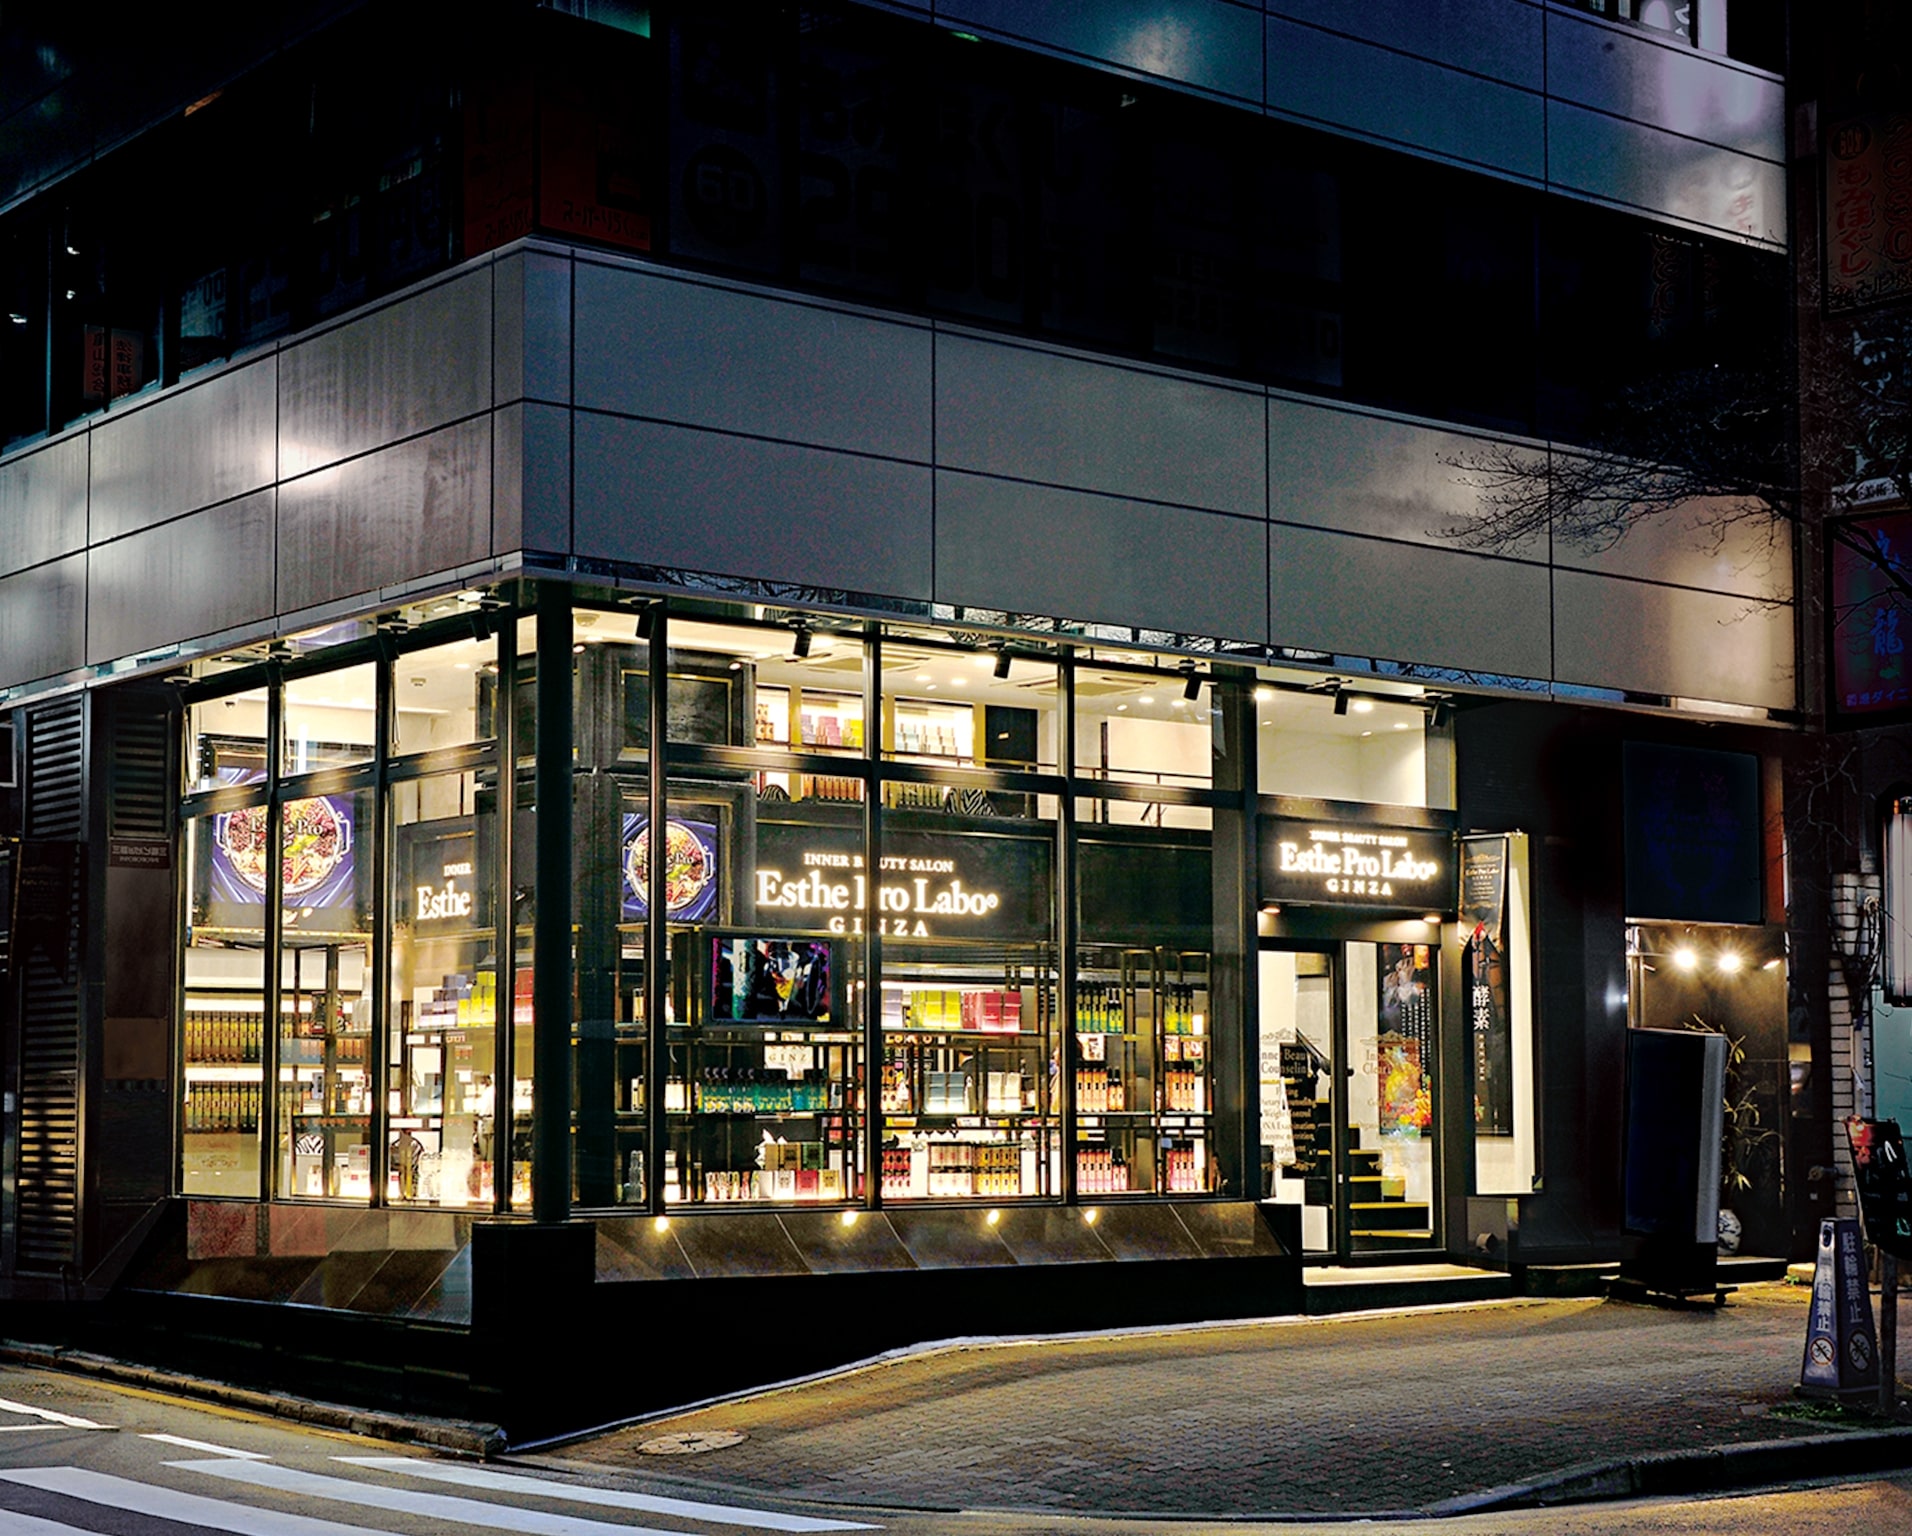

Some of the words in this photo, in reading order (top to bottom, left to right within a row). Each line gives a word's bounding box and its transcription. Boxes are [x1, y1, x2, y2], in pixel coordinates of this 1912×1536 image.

[297, 818, 324, 835] Pro
[804, 853, 850, 868] INNER
[853, 856, 907, 871] BUTY
[909, 858, 954, 873] SALON
[1279, 842, 1342, 874] Esthe
[1342, 847, 1380, 877] Pro
[416, 879, 472, 921] Esthe
[756, 870, 849, 909] Esthe
[1326, 879, 1393, 896] GINZA
[1472, 984, 1491, 1031] 酵素
[1261, 1060, 1308, 1074] Counselin
